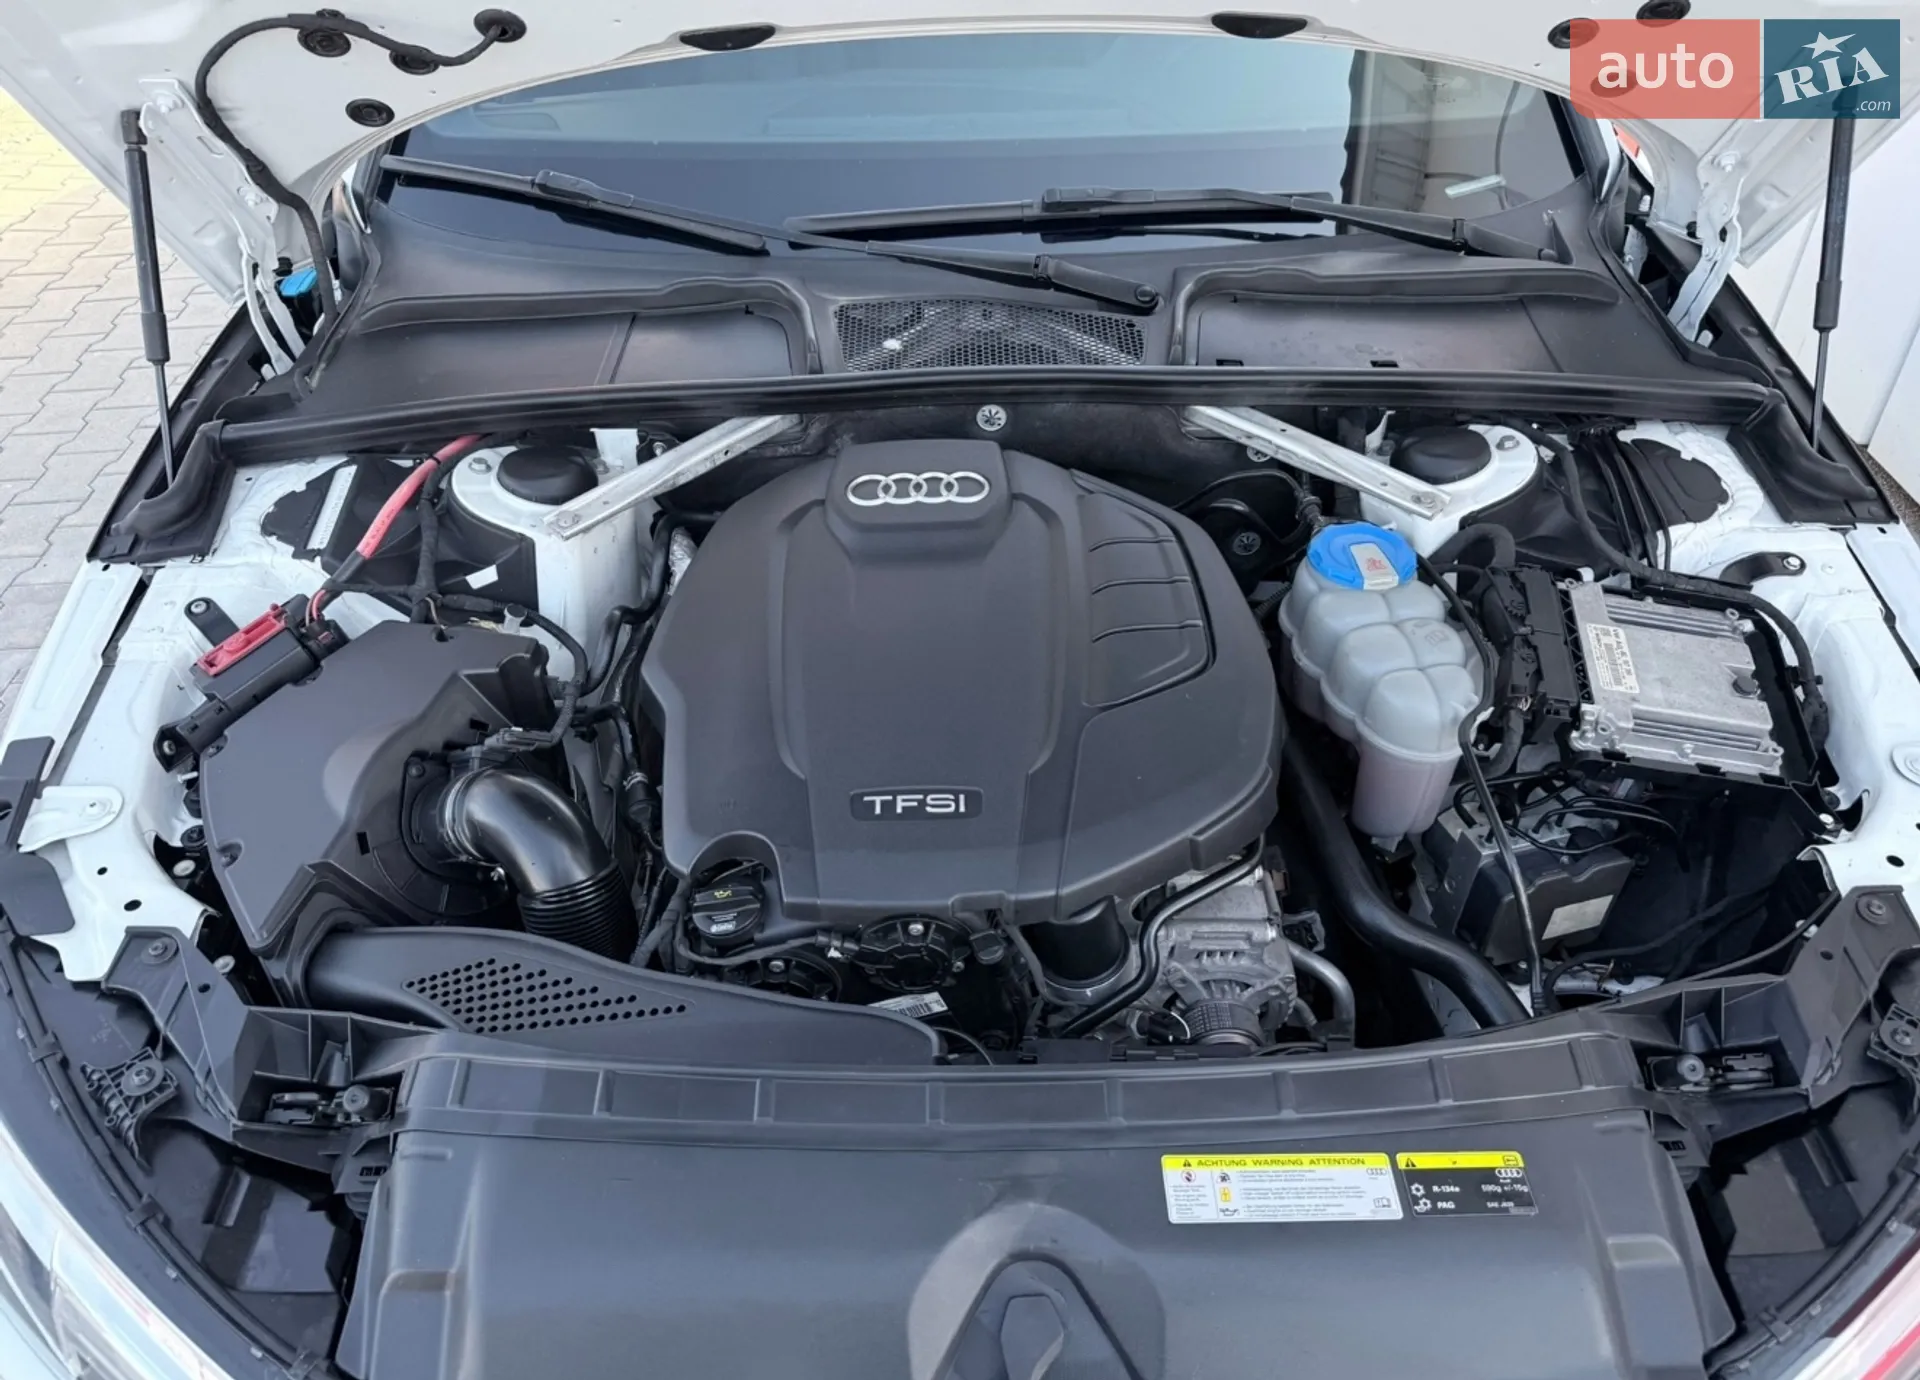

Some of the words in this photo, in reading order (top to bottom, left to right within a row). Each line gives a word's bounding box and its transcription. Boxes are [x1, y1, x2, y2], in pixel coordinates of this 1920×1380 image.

[863, 794, 965, 815] TFSI
[1197, 1159, 1247, 1167] ACHTUNG
[1253, 1158, 1303, 1166] WARNING
[1309, 1157, 1365, 1166] ATTENTION
